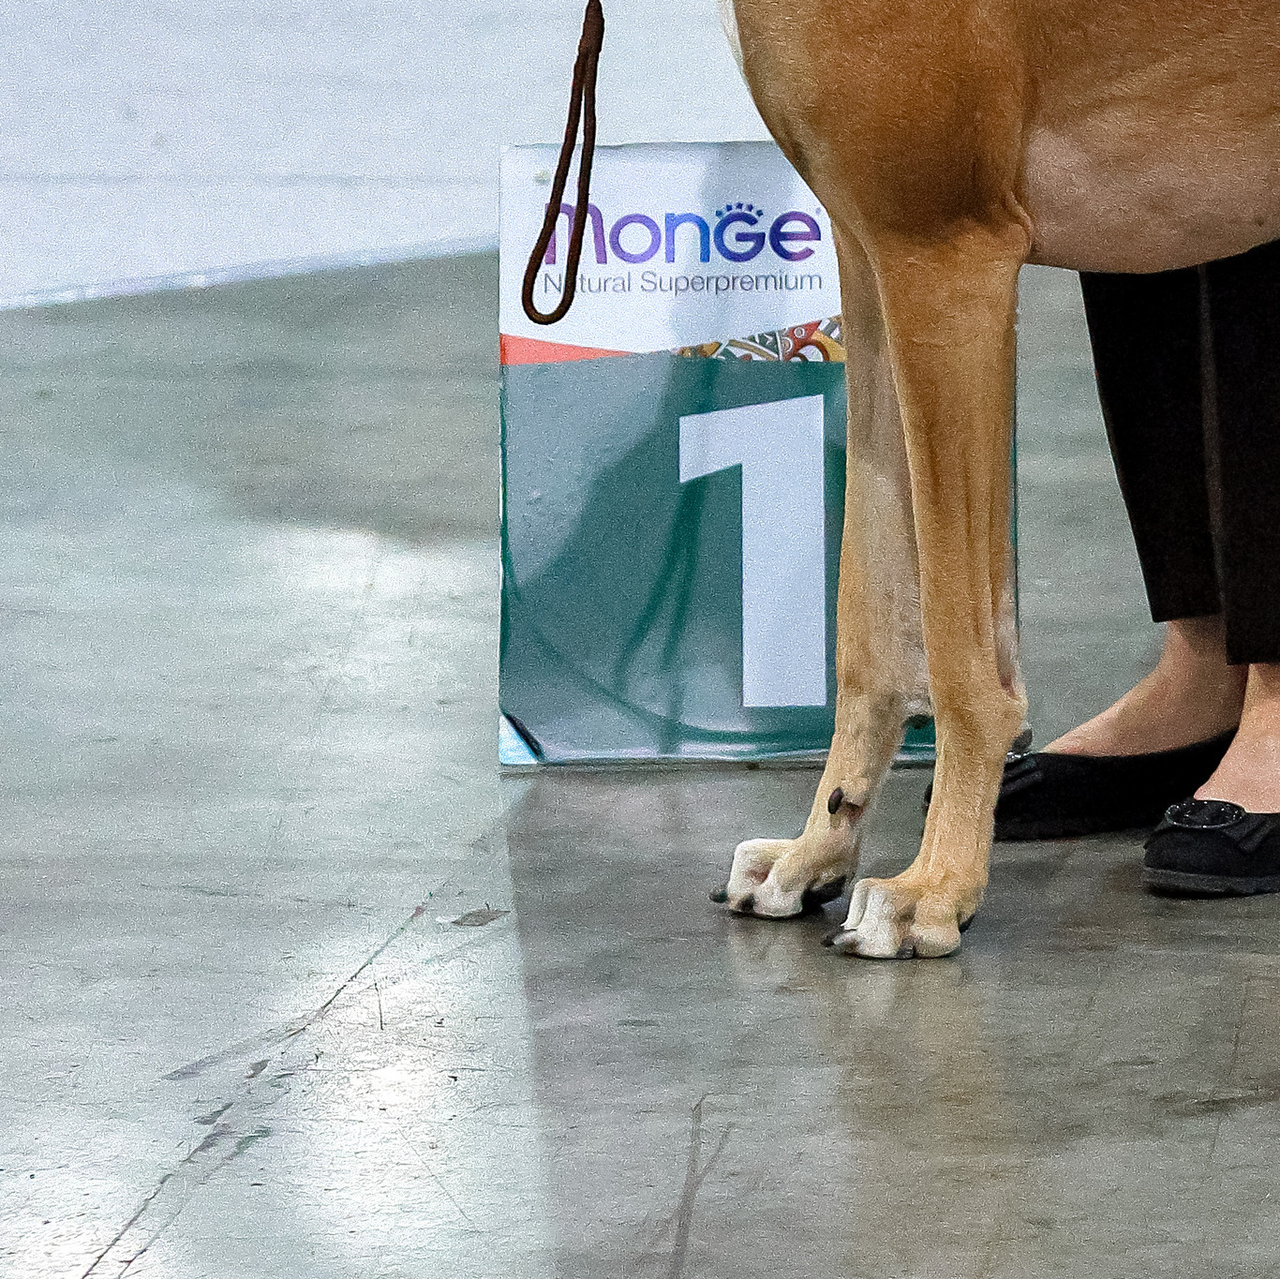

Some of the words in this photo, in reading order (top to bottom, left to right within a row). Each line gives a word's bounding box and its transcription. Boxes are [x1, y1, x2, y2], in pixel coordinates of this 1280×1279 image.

[543, 271, 632, 293] Ntural
[640, 269, 823, 296] Superpremium
[679, 394, 827, 708] 1
